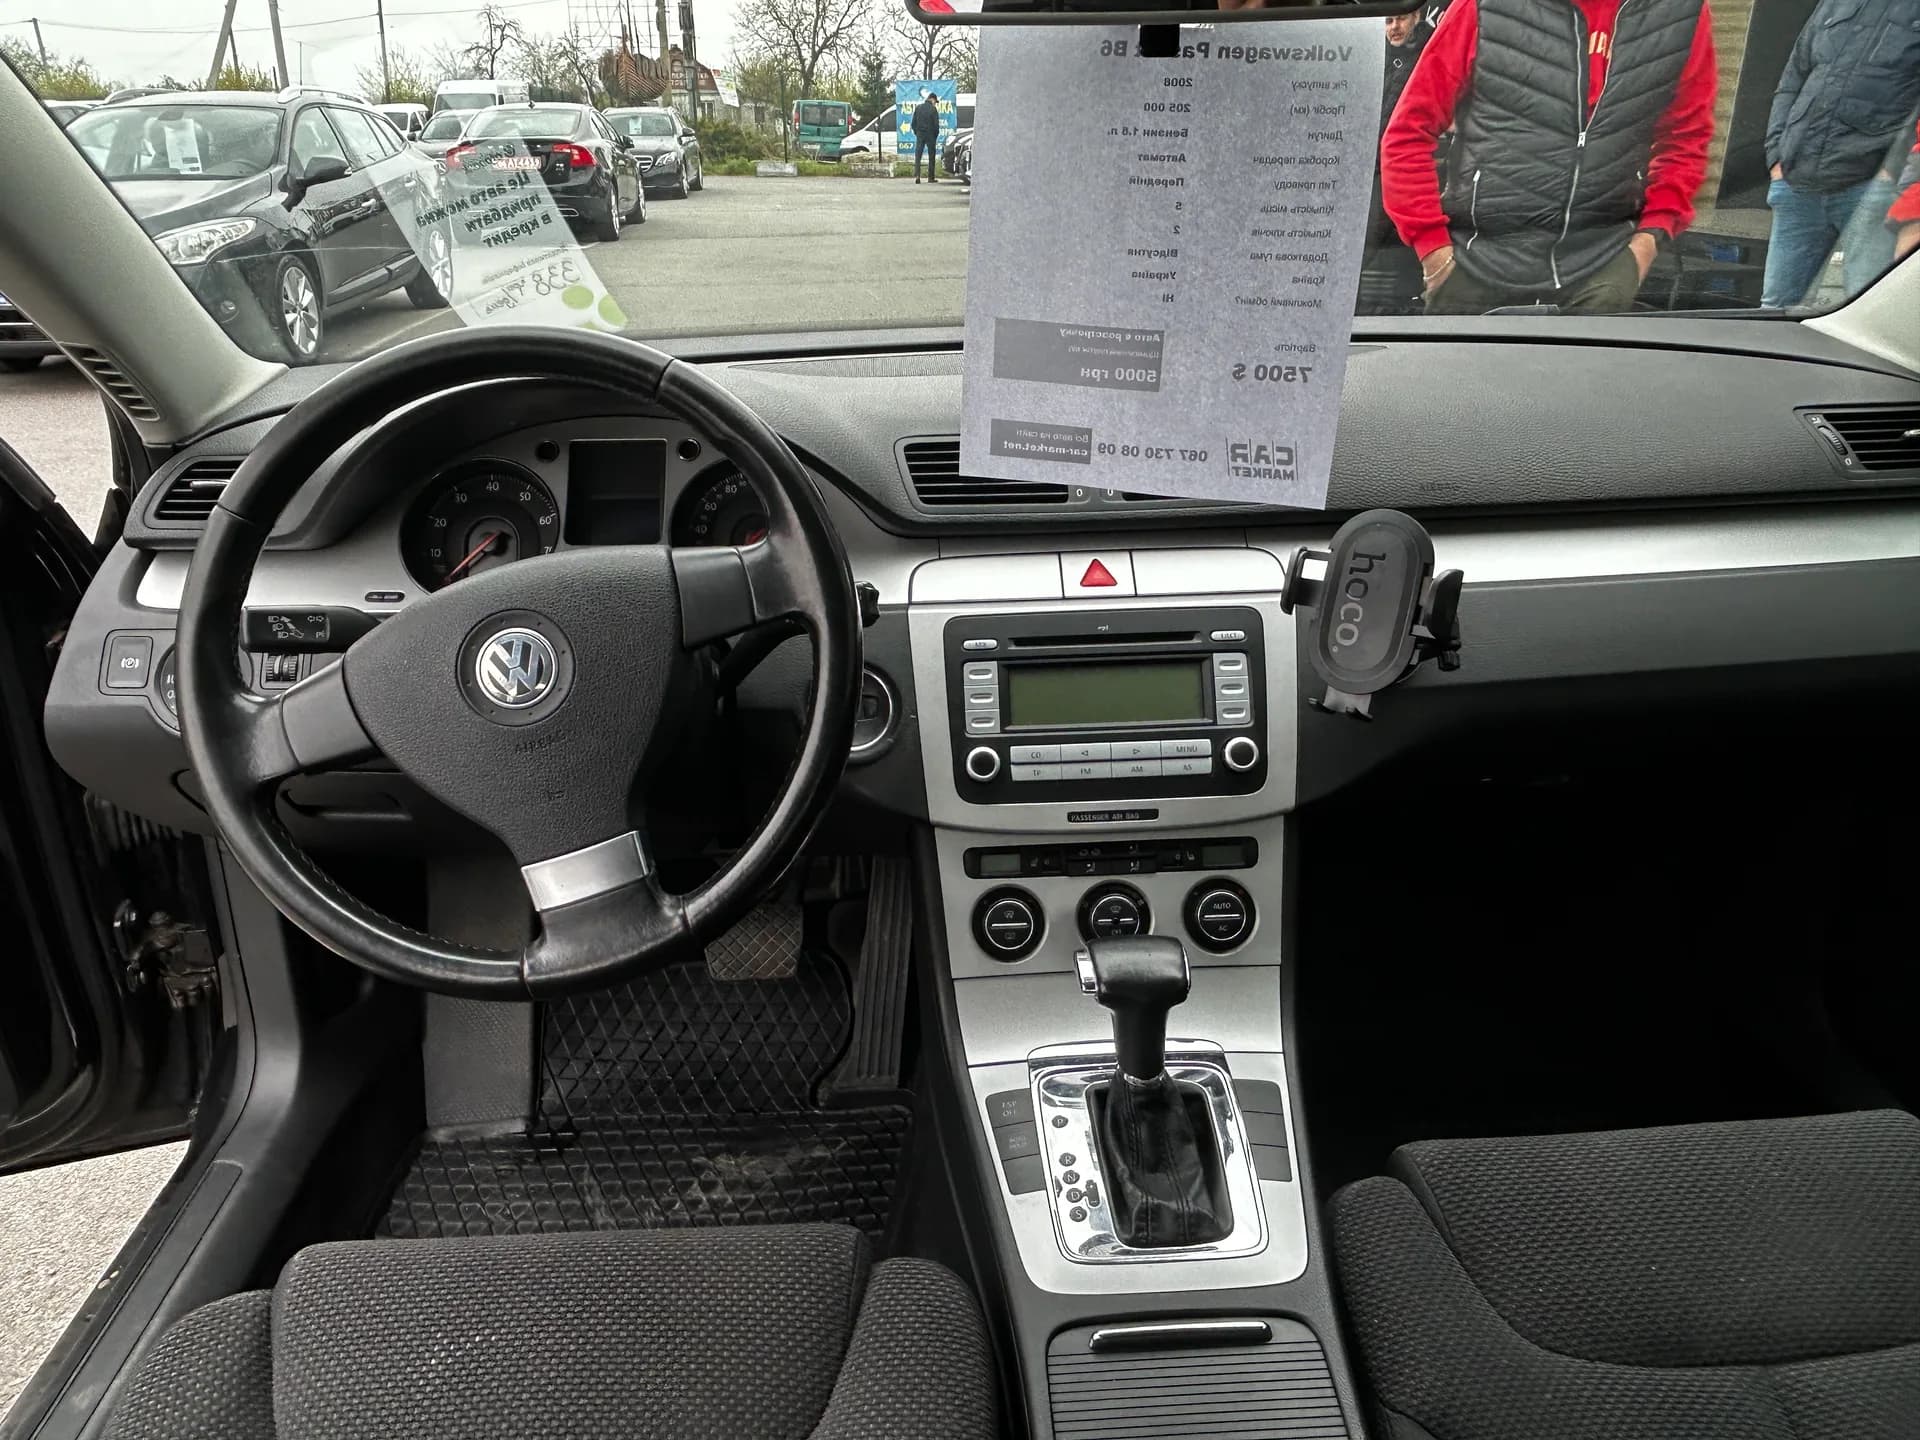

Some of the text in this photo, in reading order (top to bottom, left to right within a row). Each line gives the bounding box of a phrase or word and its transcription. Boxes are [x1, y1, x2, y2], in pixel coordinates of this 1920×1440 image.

[486, 482, 499, 491] 40
[519, 492, 531, 501] 50
[434, 517, 447, 528] 20
[539, 515, 551, 525] 60
[430, 548, 441, 558] 10
[1213, 902, 1231, 910] AUTO
